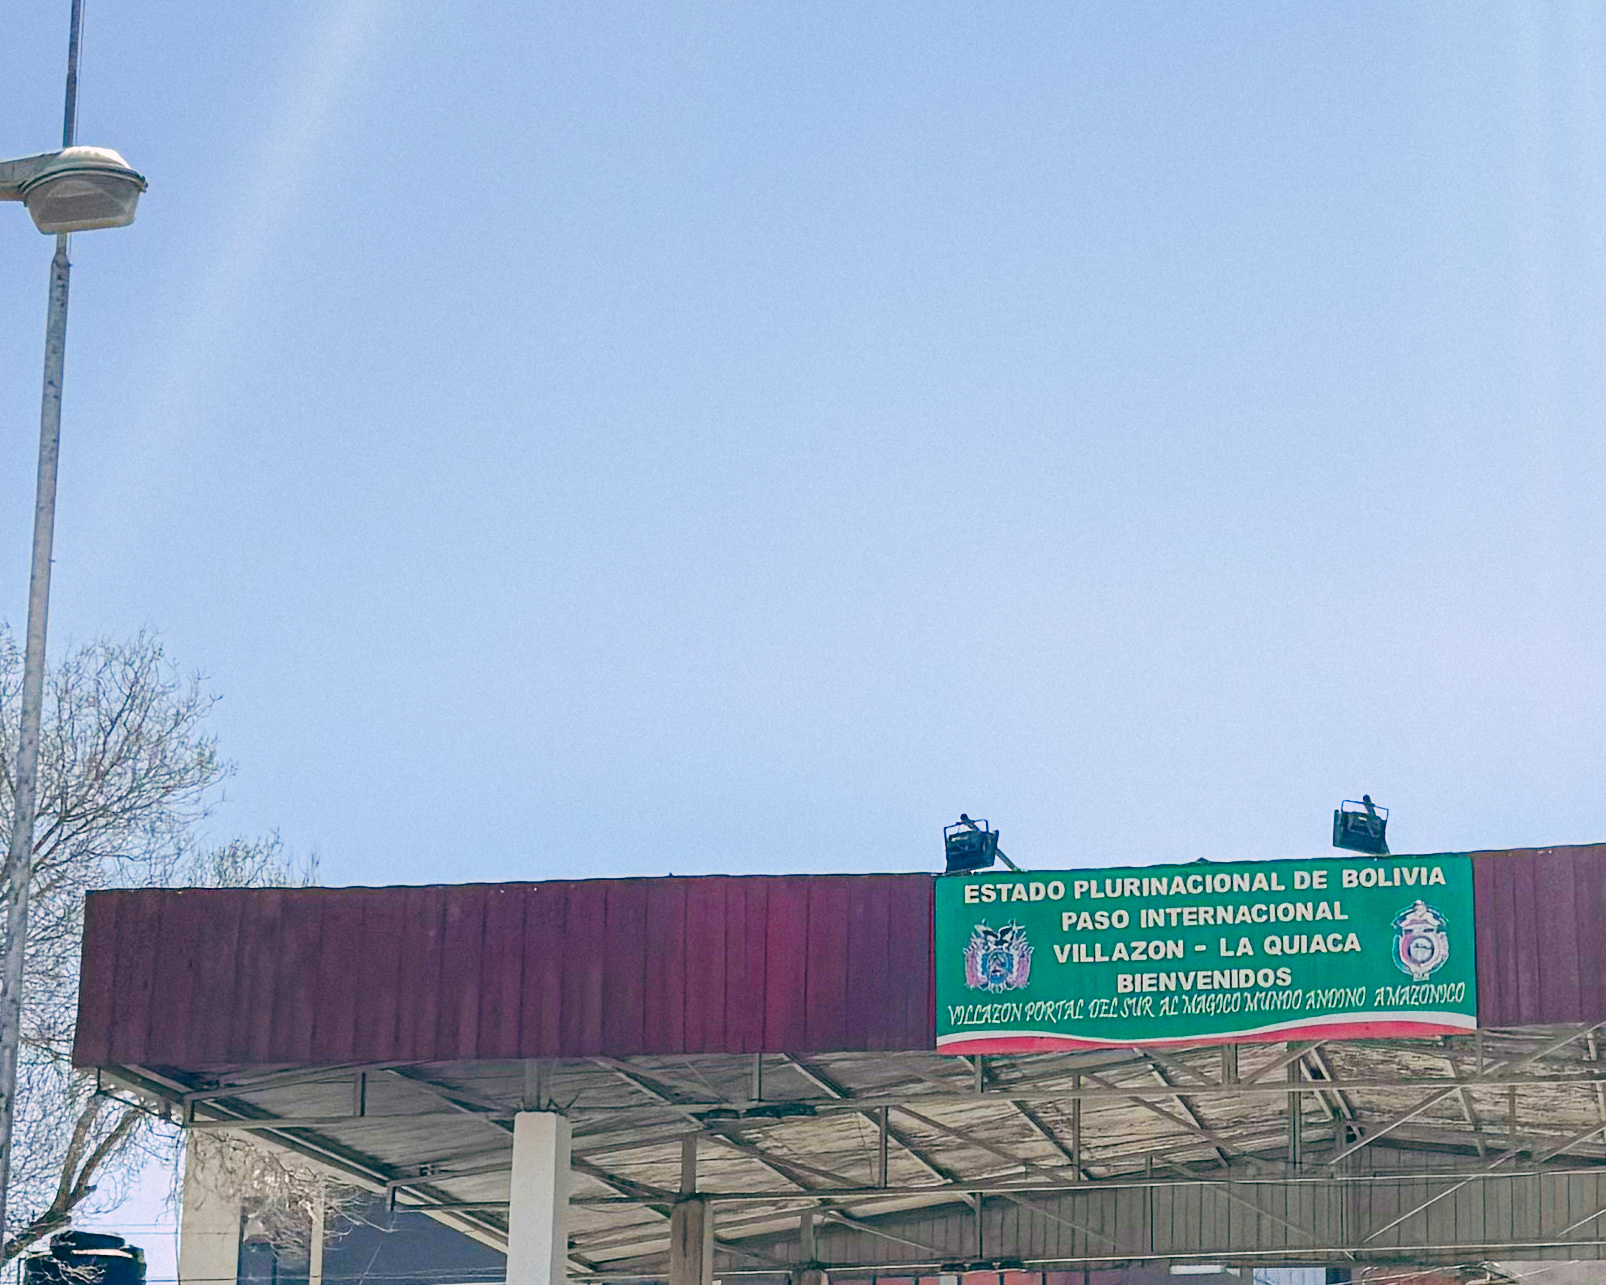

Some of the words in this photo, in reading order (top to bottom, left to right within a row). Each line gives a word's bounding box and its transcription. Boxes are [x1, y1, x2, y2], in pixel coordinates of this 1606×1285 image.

[964, 881, 1066, 904] ESTADO
[1074, 873, 1286, 899] PLURINACIONAL
[1294, 870, 1328, 890] DE
[1342, 867, 1446, 888] BOLIVIA
[1062, 909, 1130, 932] PASO
[1140, 901, 1349, 928] INTERNACIONAL
[1053, 940, 1184, 963] VILLAZON
[1220, 937, 1254, 957] LA
[1263, 933, 1362, 956] QUIACA
[1117, 968, 1292, 993] BIENVENIDOS
[948, 1001, 1023, 1026] VILLAZON
[1025, 999, 1085, 1024] PORTAL
[1088, 997, 1118, 1018] DEL
[1120, 996, 1155, 1019] SUR
[1160, 996, 1180, 1017] AL
[1182, 991, 1241, 1016] MAGICO
[1244, 989, 1302, 1013] MUNDO
[1305, 986, 1367, 1011] ANDINO
[1374, 981, 1466, 1008] AMAZONICO
